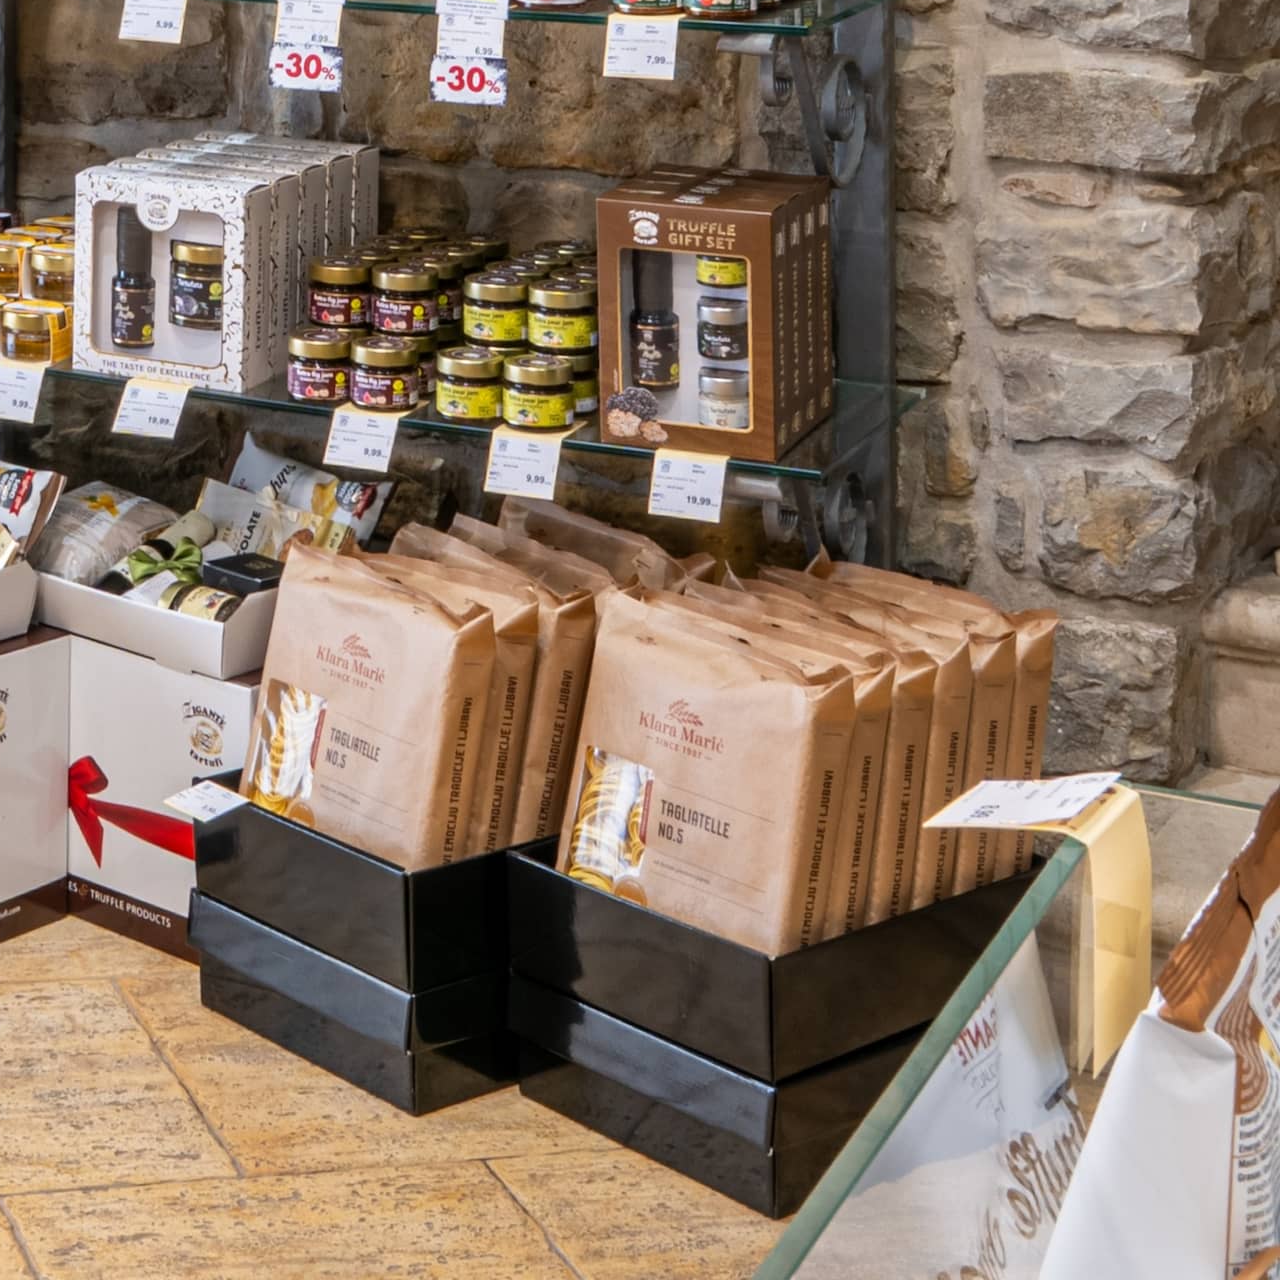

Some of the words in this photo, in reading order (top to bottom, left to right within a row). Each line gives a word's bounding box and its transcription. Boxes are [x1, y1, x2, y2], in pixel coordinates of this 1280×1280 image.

[666, 219, 737, 237] TRUFFLE
[668, 233, 703, 247] GIFT
[706, 236, 736, 251] SET
[102, 359, 117, 368] THE
[119, 361, 144, 371] TASTE
[147, 365, 157, 373] OF
[159, 367, 211, 381] EXCELLENCE
[268, 463, 297, 502] hips
[316, 645, 350, 670] Klara
[329, 670, 350, 684] SINCE
[460, 697, 473, 742] LJUBAVI
[505, 675, 518, 724] LJUBAVI
[540, 778, 554, 820] EMOCIJU
[550, 723, 566, 776] TRADICIJE
[561, 670, 575, 717] LJUBAVI
[639, 711, 678, 737] Klara
[655, 737, 680, 752] SINCE
[189, 749, 224, 767] tartufi
[326, 748, 347, 770] NO.5
[330, 727, 381, 765] TAGLIATELLE
[496, 730, 511, 781] TRADICIJE
[451, 749, 466, 803] TRADICIJE
[860, 755, 873, 804] LJUBAVI
[903, 744, 916, 792] LJUBAVI
[445, 805, 458, 852] EMOCIJU
[490, 783, 503, 832] EMOCIJU
[660, 799, 731, 841] TAGLIATELLE
[658, 822, 684, 847] NO.5
[852, 812, 867, 872] TRADICIJE
[895, 800, 911, 859] TRADICIJE
[804, 887, 819, 936] EMOCIJU
[812, 826, 827, 885] TRADICIJE
[820, 769, 835, 816] LJUBAVI
[848, 874, 861, 920] EMOCIJU
[891, 861, 904, 908] EMOCIJU
[91, 888, 125, 911] TRUFFLE
[126, 902, 172, 929] PRODUCTS
